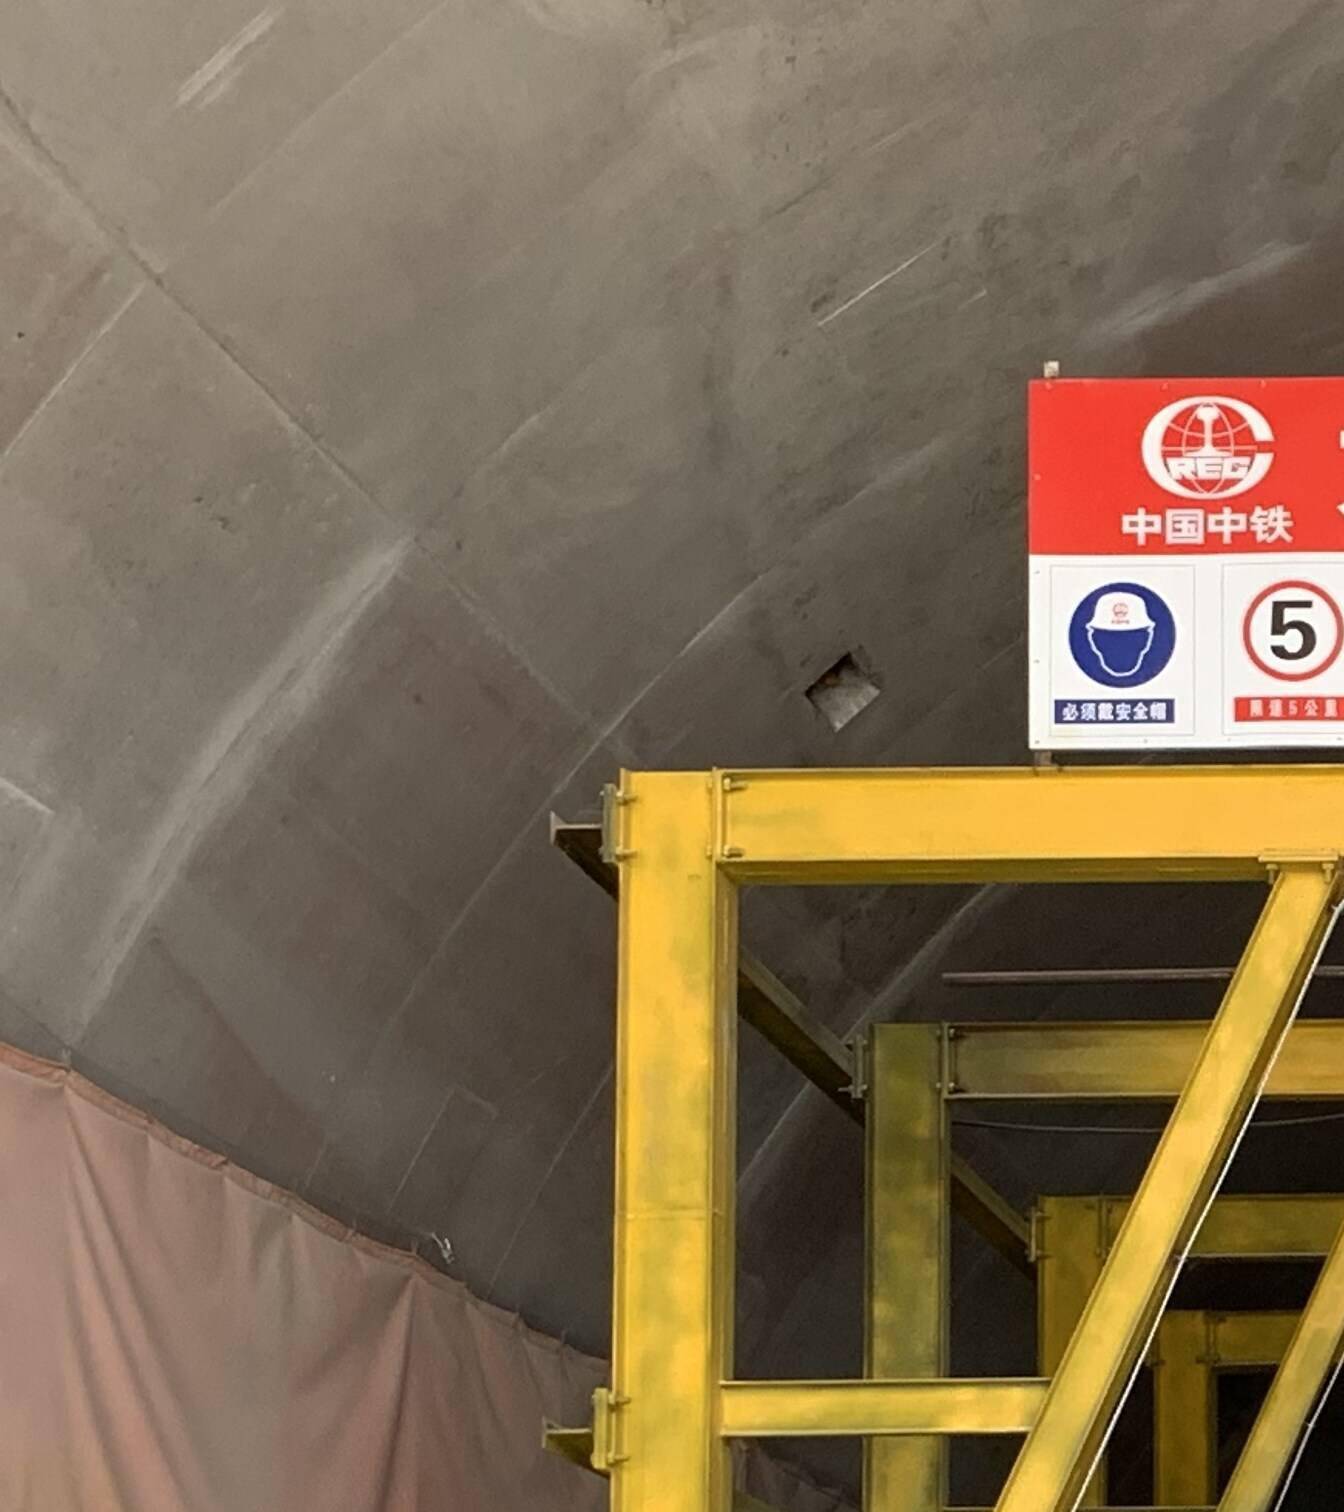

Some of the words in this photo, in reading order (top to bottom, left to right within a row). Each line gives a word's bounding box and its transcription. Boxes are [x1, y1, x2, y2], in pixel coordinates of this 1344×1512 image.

[1121, 505, 1294, 546] 中国中铁
[1270, 600, 1317, 660] 5
[1062, 702, 1167, 721] 必须戴安全帽
